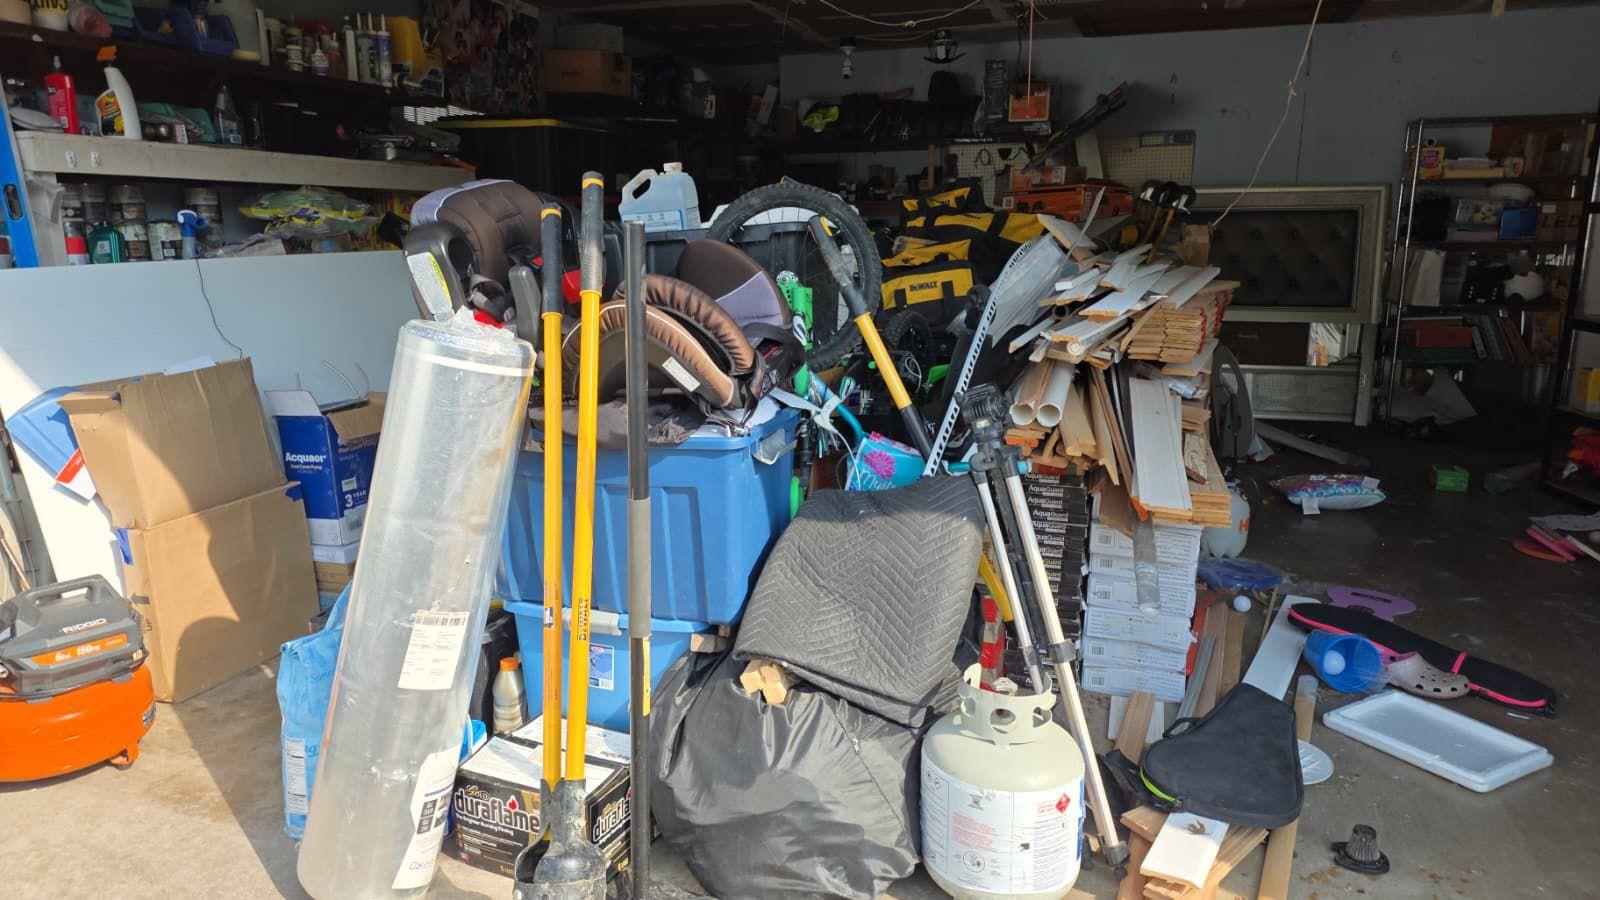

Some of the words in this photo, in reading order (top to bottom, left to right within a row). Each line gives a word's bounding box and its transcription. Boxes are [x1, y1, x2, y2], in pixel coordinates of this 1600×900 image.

[285, 452, 326, 463] Acquaer
[1028, 484, 1064, 494] AquaGuard
[345, 494, 353, 508] 3
[1027, 496, 1063, 505] AquaGuard
[1033, 509, 1069, 519] AquaGuard
[62, 618, 107, 632] RIDGID
[454, 788, 541, 836] duraflame
[592, 797, 632, 842] durafla
